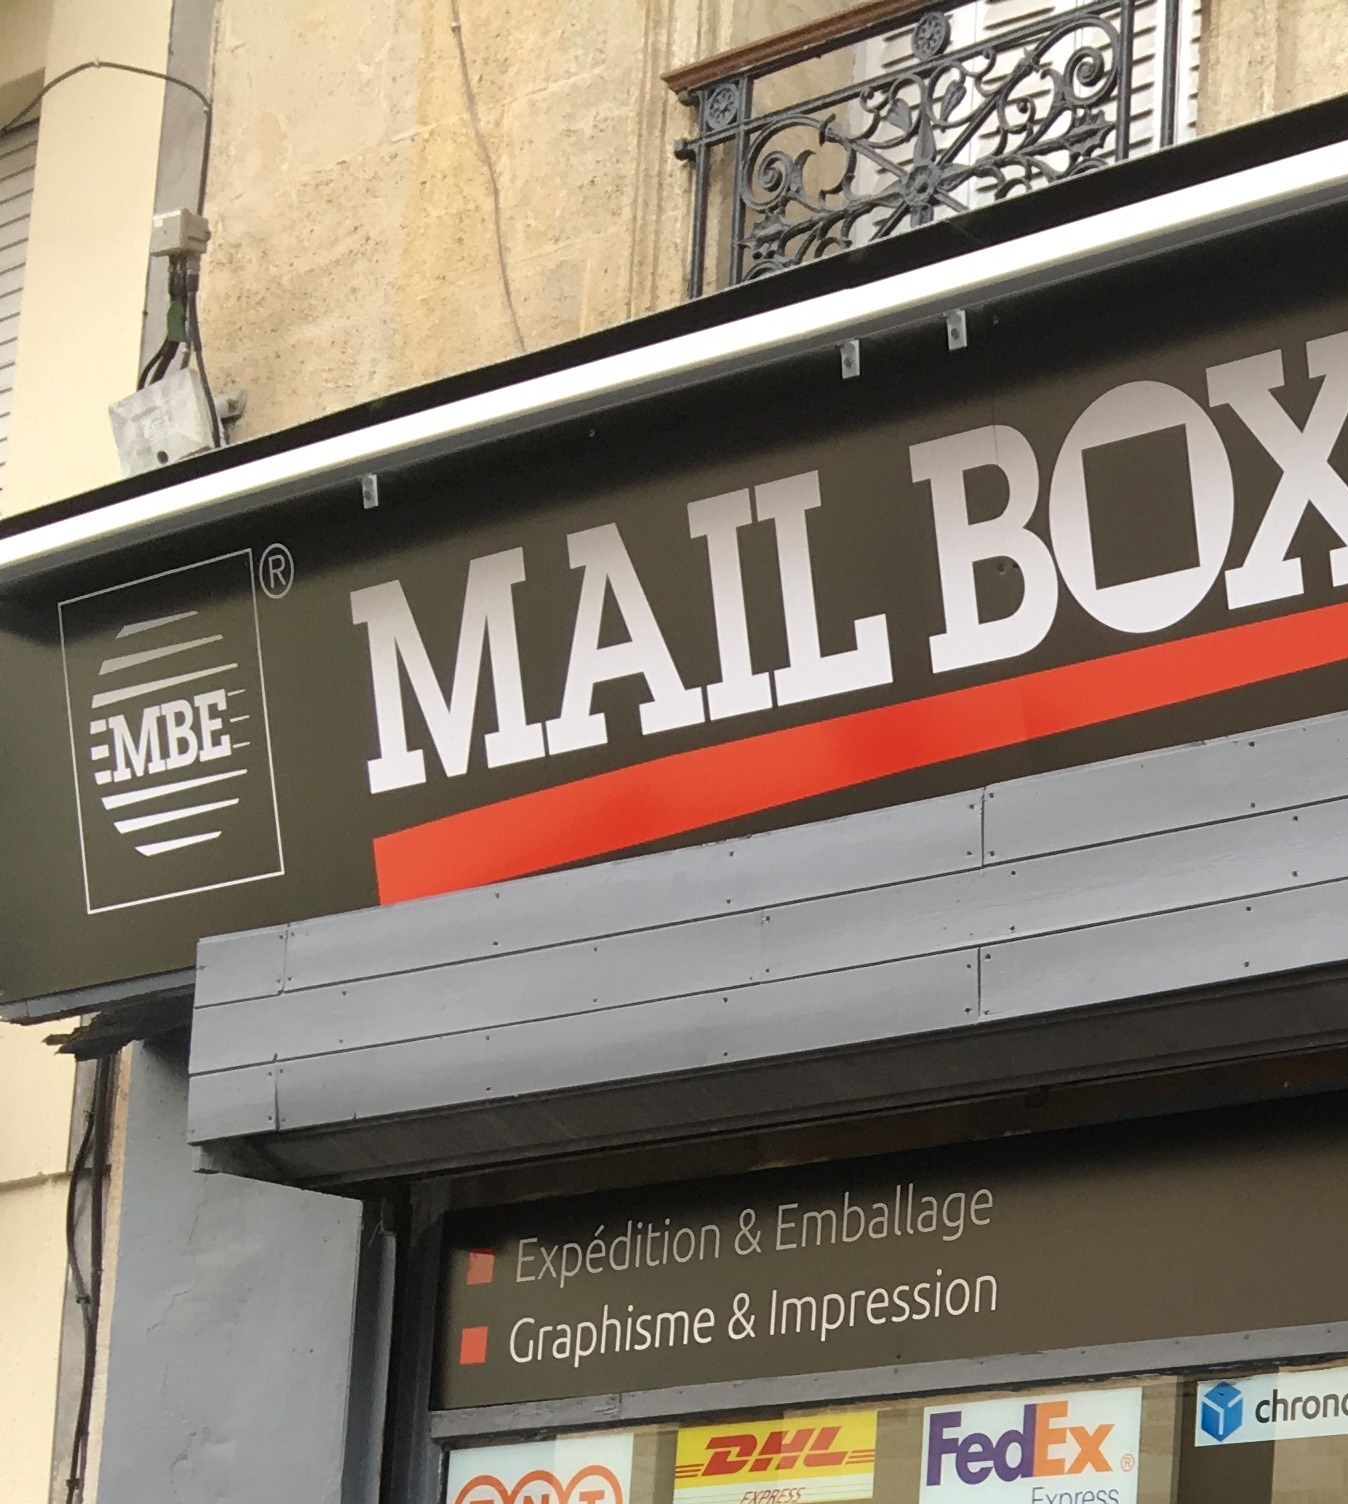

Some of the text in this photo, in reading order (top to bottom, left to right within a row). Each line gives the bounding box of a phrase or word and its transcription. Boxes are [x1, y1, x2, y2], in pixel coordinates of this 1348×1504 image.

[350, 470, 893, 794] MAIL
[109, 688, 232, 784] MBE
[515, 1182, 994, 1288] Expédition & Emballage
[509, 1268, 997, 1367] Graphisme & Impression
[701, 1425, 850, 1477] DHL
[926, 1400, 1115, 1487] FedEx
